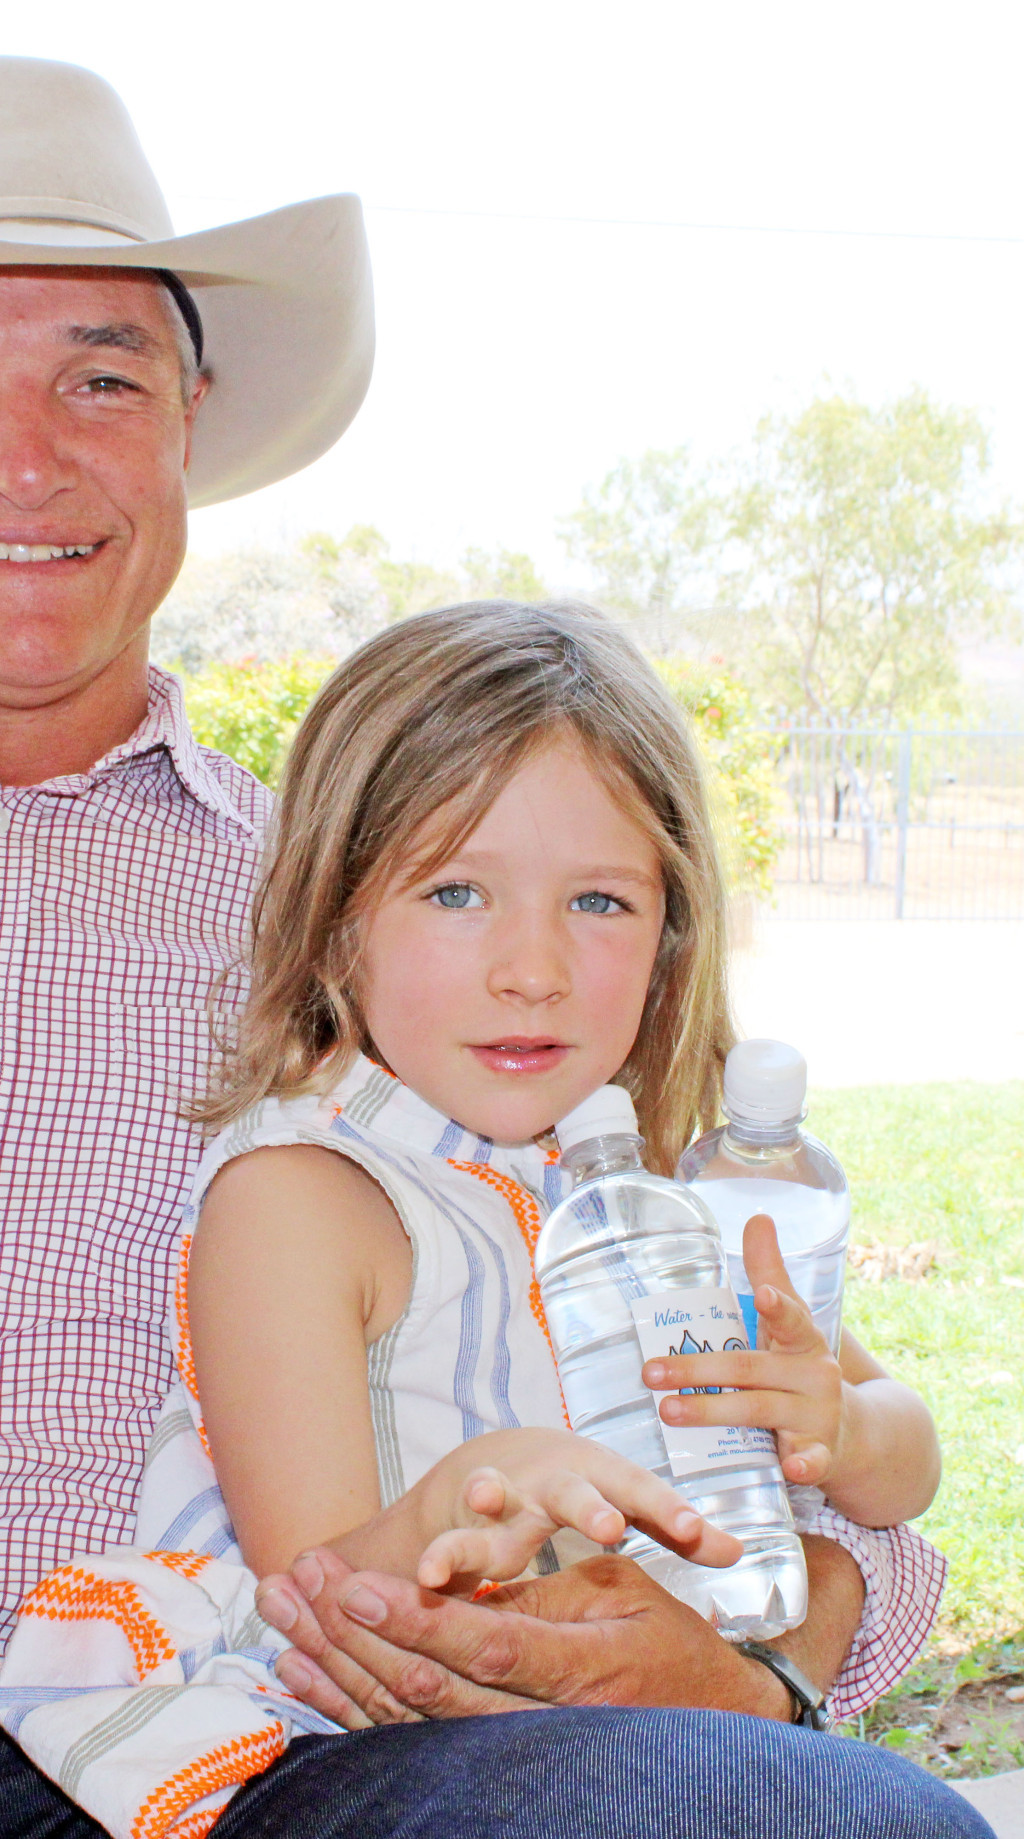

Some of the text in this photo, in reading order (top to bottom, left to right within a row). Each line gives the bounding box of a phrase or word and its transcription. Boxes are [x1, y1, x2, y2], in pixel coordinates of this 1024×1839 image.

[654, 1308, 692, 1327] Water
[709, 1304, 724, 1319] the
[726, 1427, 736, 1435] 20
[718, 1438, 739, 1446] Phone
[707, 1449, 729, 1459] email:
